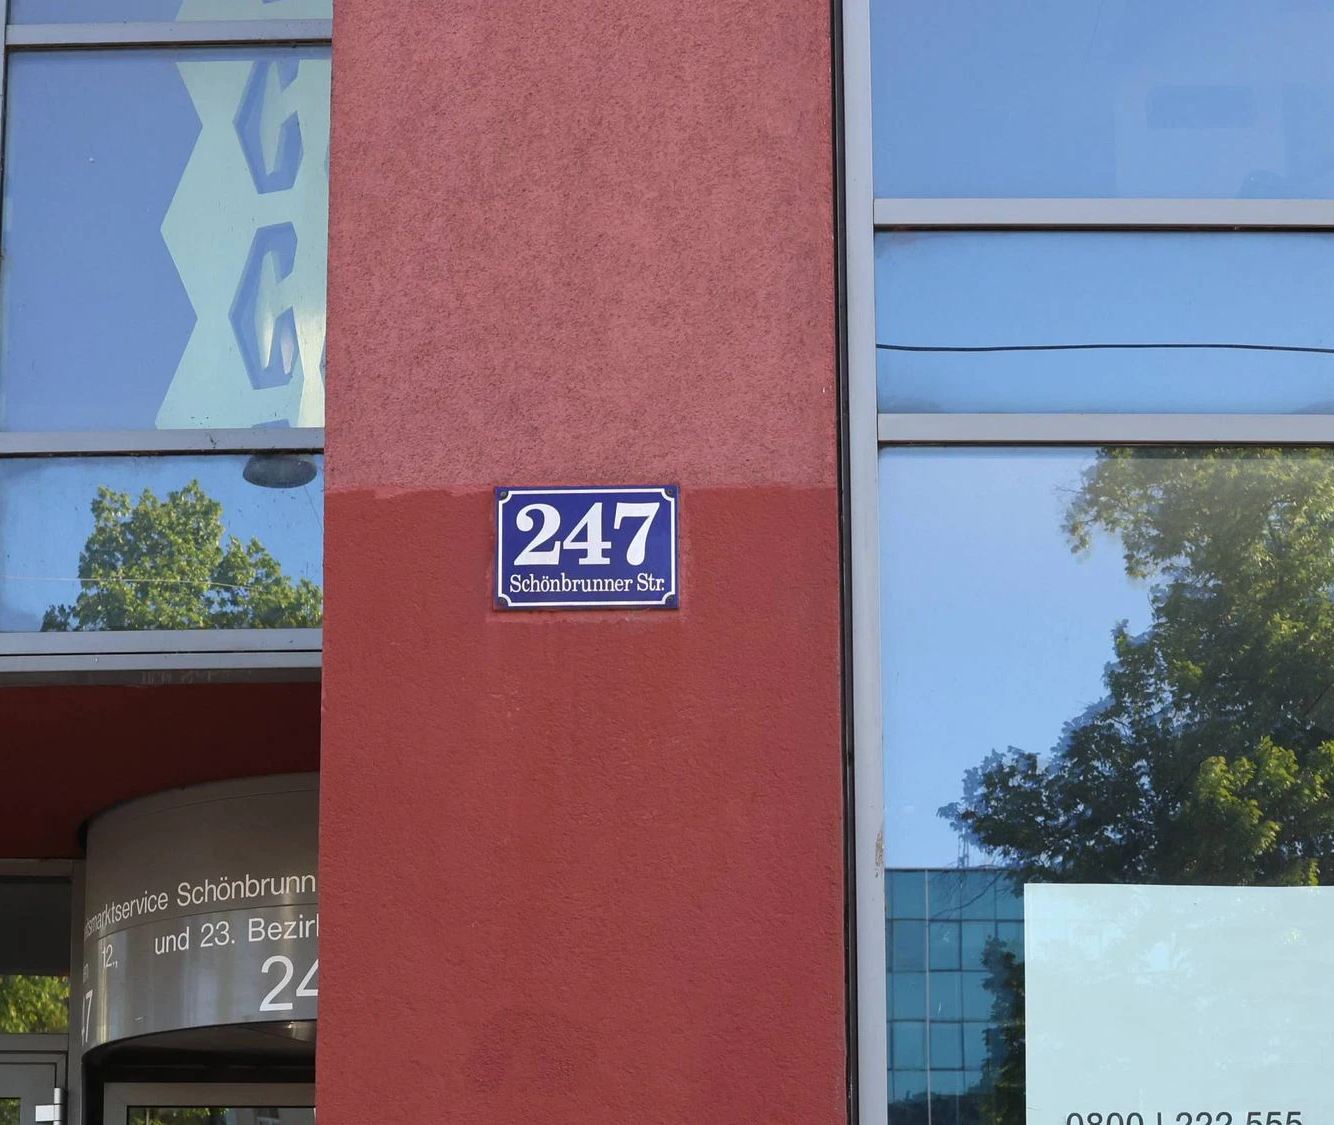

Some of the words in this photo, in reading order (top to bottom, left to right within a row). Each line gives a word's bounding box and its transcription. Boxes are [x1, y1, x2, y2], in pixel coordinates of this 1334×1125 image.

[514, 502, 660, 566] 247
[509, 573, 633, 592] Schönbrunner
[637, 572, 666, 592] Str.
[176, 874, 316, 906] Schönbrunn
[154, 926, 190, 955] und
[200, 920, 236, 948] 23.
[248, 913, 319, 943] Bezir
